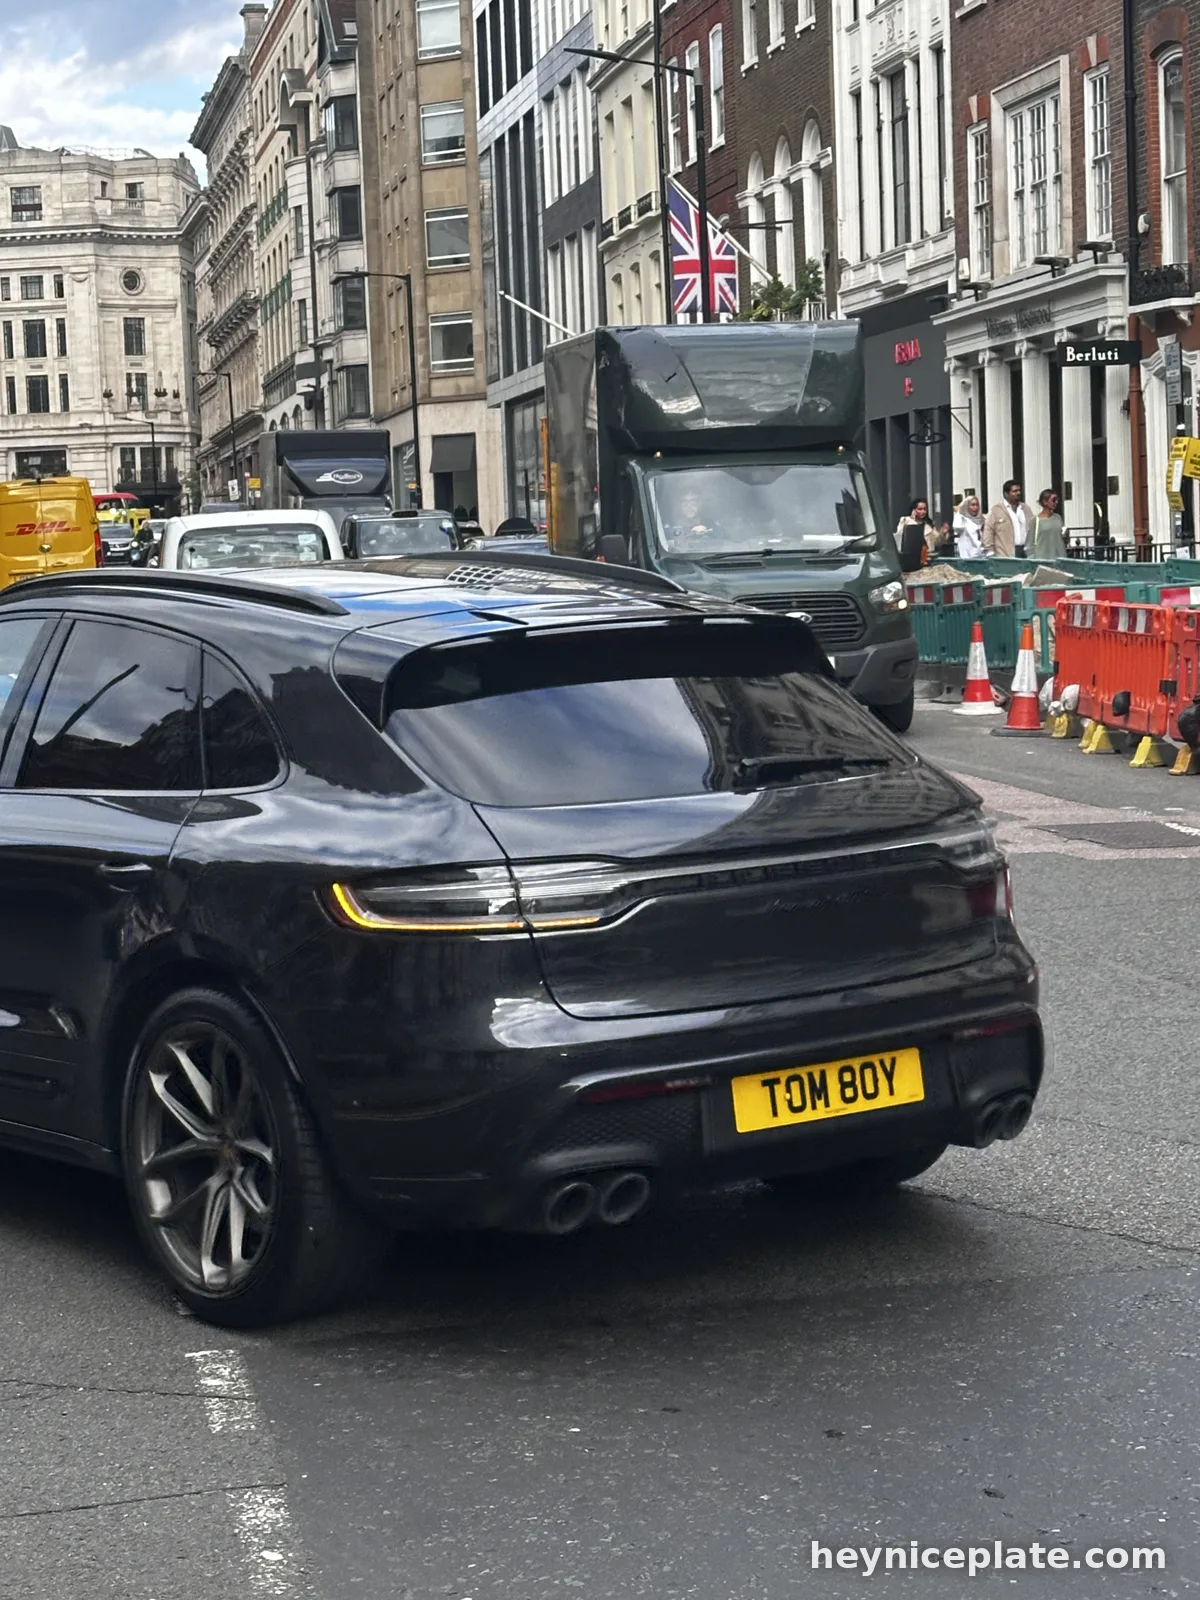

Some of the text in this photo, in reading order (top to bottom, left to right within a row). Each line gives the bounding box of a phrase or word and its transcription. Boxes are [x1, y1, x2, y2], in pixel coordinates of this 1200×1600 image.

[1065, 345, 1120, 362] Berluti
[15, 520, 71, 536] DHL
[760, 1069, 830, 1118] TOM
